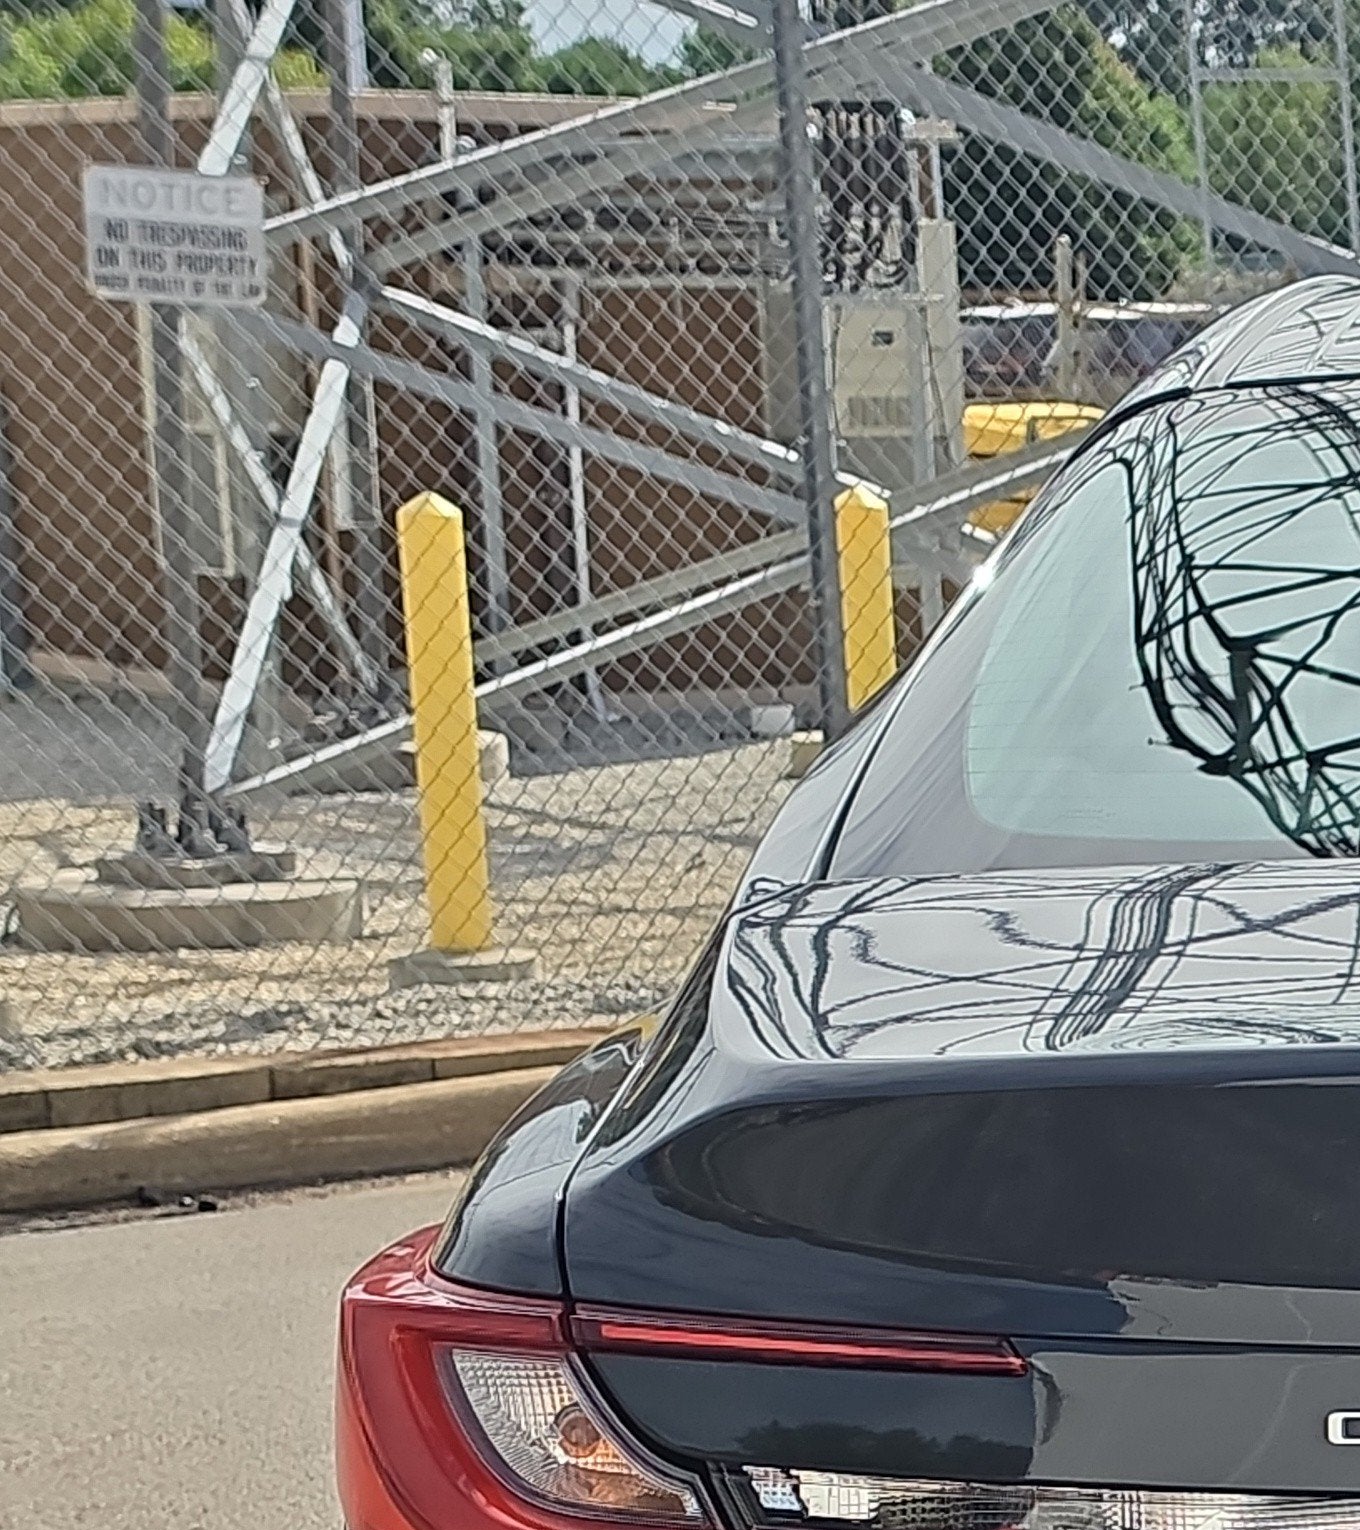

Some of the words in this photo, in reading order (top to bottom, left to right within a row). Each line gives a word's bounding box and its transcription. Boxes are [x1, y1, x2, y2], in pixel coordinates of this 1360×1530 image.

[102, 176, 246, 217] NOTICE
[105, 217, 129, 243] NO
[139, 219, 248, 251] TRESPASSING
[95, 247, 120, 268] ON
[130, 249, 168, 273] THIS
[176, 252, 258, 276] PROPERTY
